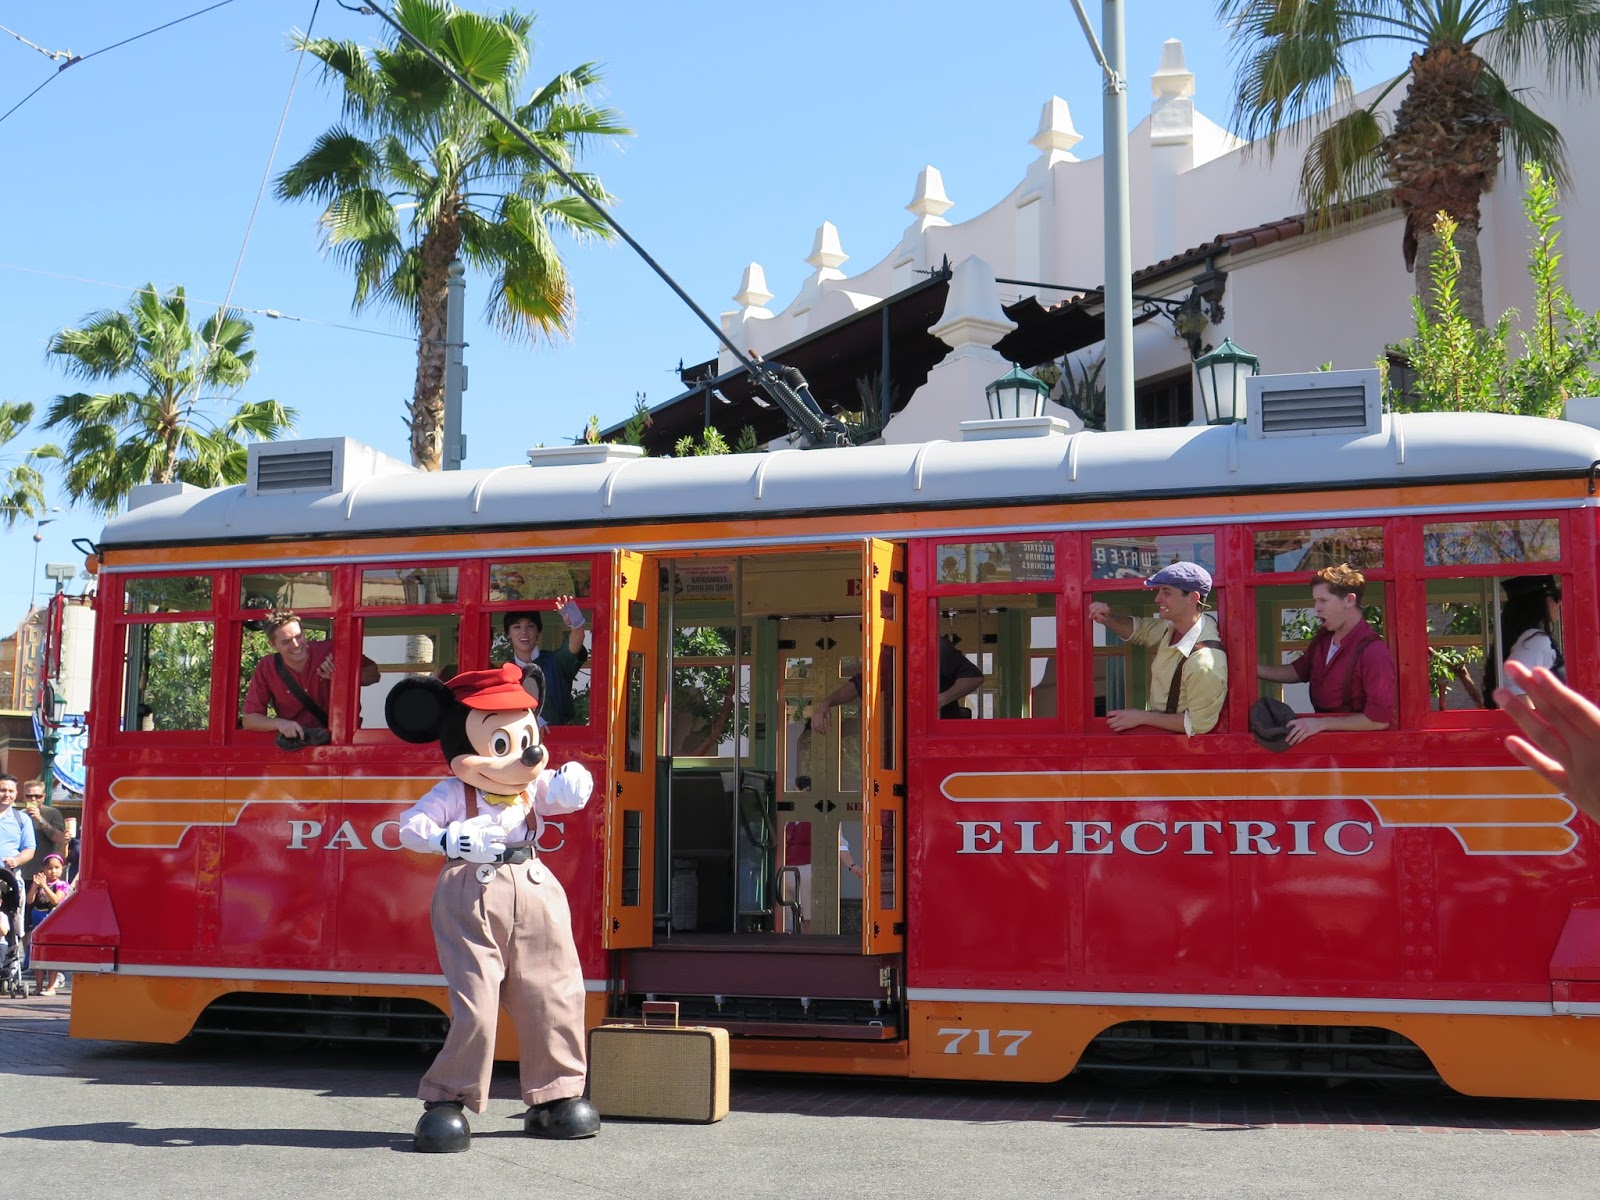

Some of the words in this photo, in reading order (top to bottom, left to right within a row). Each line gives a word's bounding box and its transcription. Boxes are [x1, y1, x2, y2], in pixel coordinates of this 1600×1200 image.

[25, 628, 42, 708] DISNE
[955, 821, 1376, 856] ELECTRIC
[937, 1027, 1033, 1056] 717
